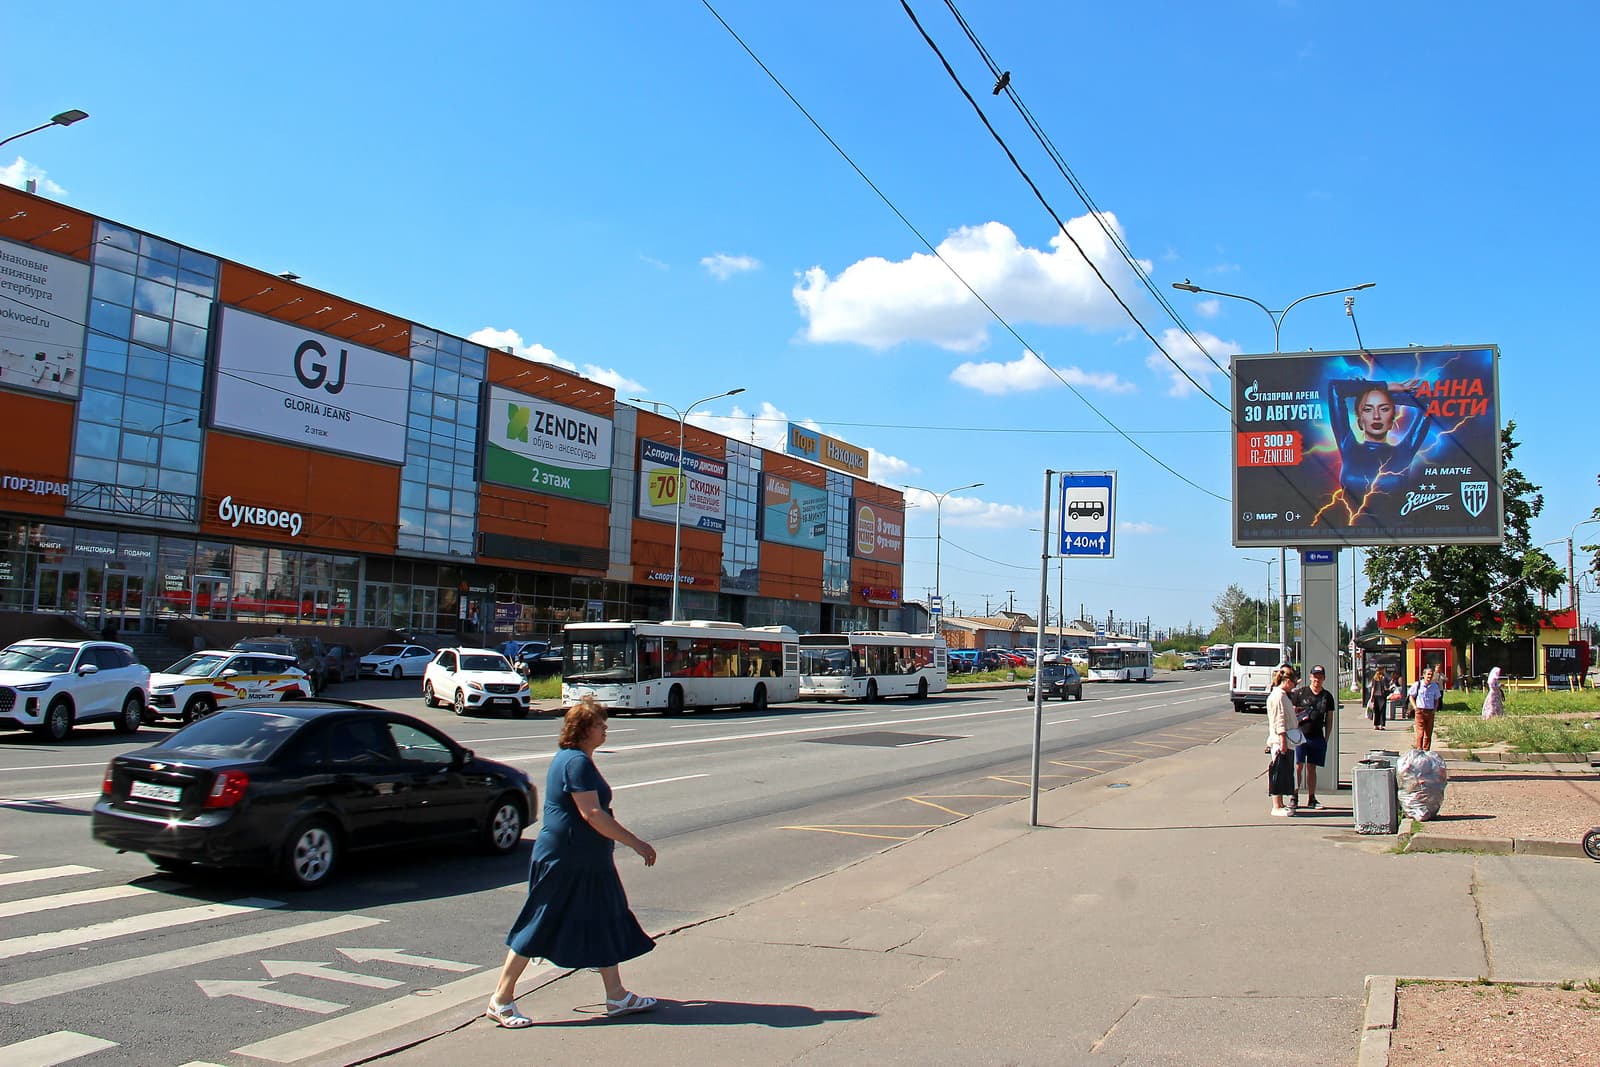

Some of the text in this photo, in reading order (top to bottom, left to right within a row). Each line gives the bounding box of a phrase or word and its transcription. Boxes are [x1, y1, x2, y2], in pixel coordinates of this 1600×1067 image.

[0, 250, 48, 272] наковые
[0, 280, 53, 300] етербурга
[0, 308, 50, 328] okvoed.ru
[294, 339, 348, 394] GJ
[1259, 391, 1320, 401] ГАЗПРОМ АРЕНА
[1416, 378, 1484, 398] АННА
[284, 398, 351, 422] GLORIA JEANS
[1244, 404, 1323, 422] 30 АВГУСТА
[1424, 398, 1488, 417] АСТИ
[304, 425, 328, 437] 2 этаж
[534, 410, 598, 447] ZENDEN
[533, 436, 597, 461] обувь аксессуары
[792, 429, 864, 469] Порт Находка
[1250, 437, 1261, 448] ОТ
[651, 448, 699, 469] спортмстер
[1250, 448, 1294, 463] FC-ZENIT.RU
[531, 467, 571, 489] 2 этаж
[1424, 466, 1473, 477] НА МАТЧЕ
[3, 475, 69, 496] ГОРЗДРАВ
[690, 479, 720, 497] СКИДКИ
[877, 517, 882, 532] 3
[1285, 511, 1301, 522] 0+
[75, 545, 116, 554] КАНЦТОВАРЫ
[124, 549, 151, 557] ПОДАРКИ
